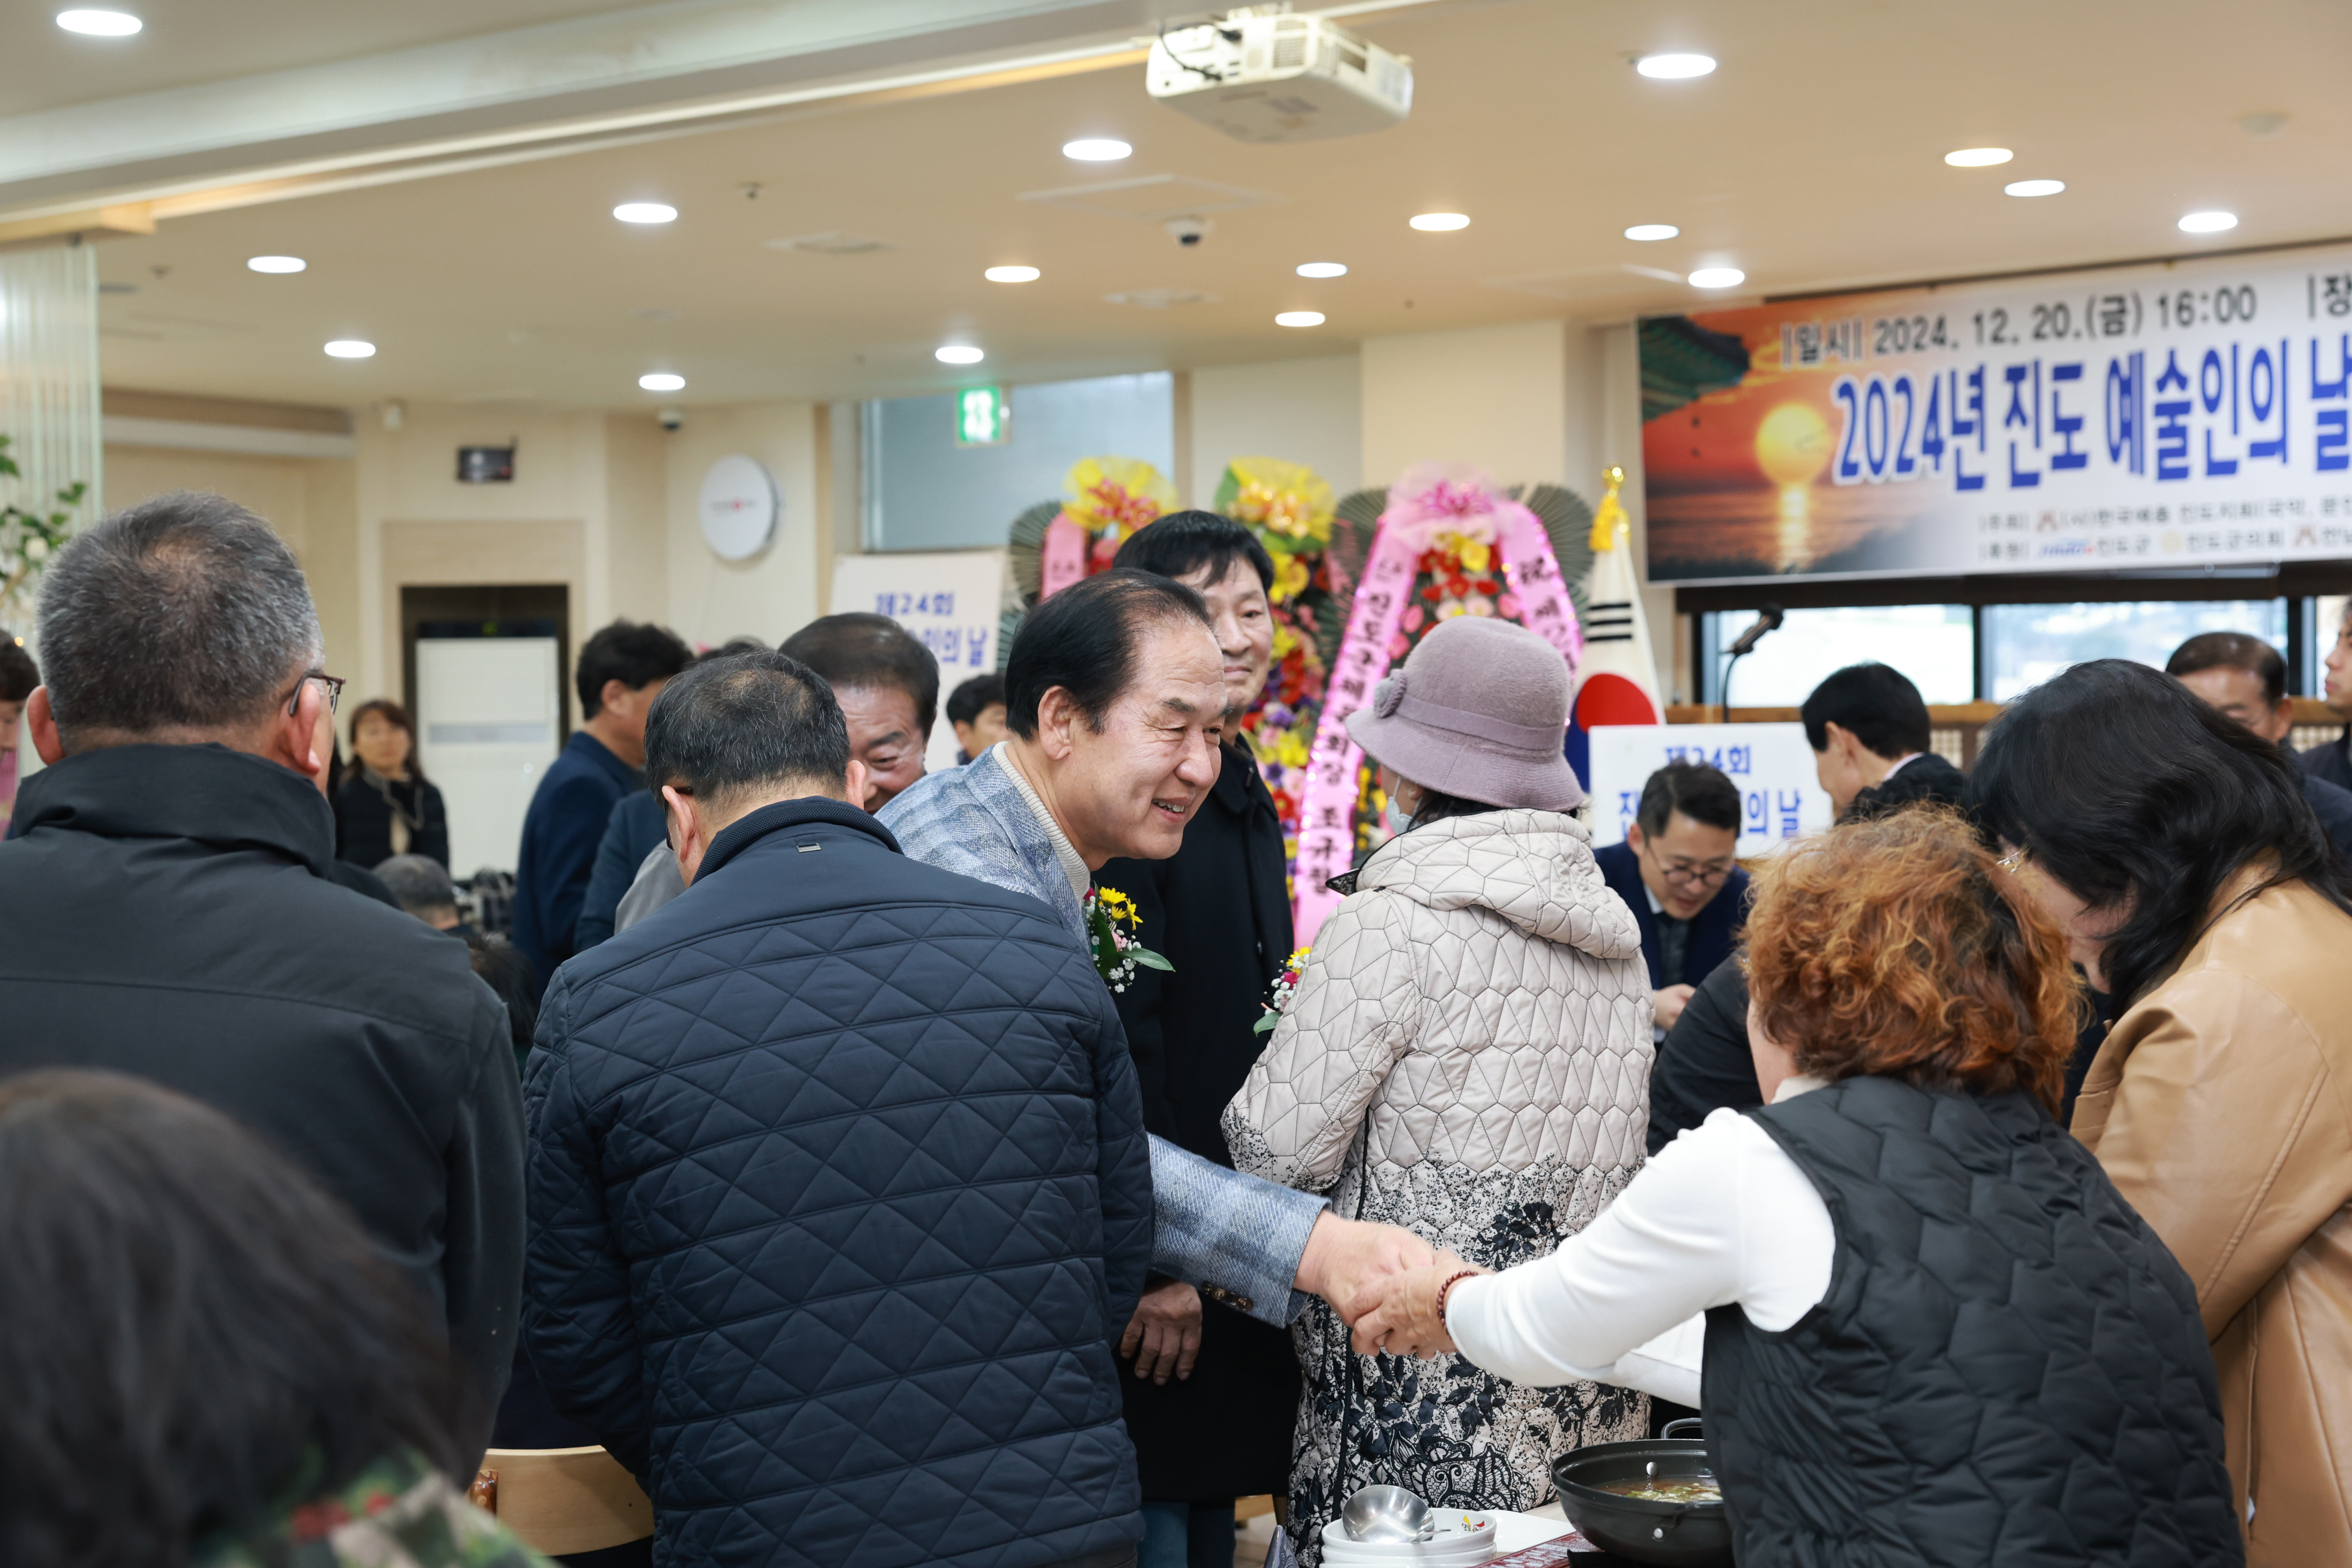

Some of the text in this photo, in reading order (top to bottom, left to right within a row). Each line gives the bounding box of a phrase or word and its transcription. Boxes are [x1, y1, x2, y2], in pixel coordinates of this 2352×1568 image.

[1874, 315, 1958, 354] 2024.
[1972, 308, 2019, 345] 12.
[2156, 283, 2257, 327] 16:00
[1838, 333, 2352, 492] 2024년 진도 예술인의 날
